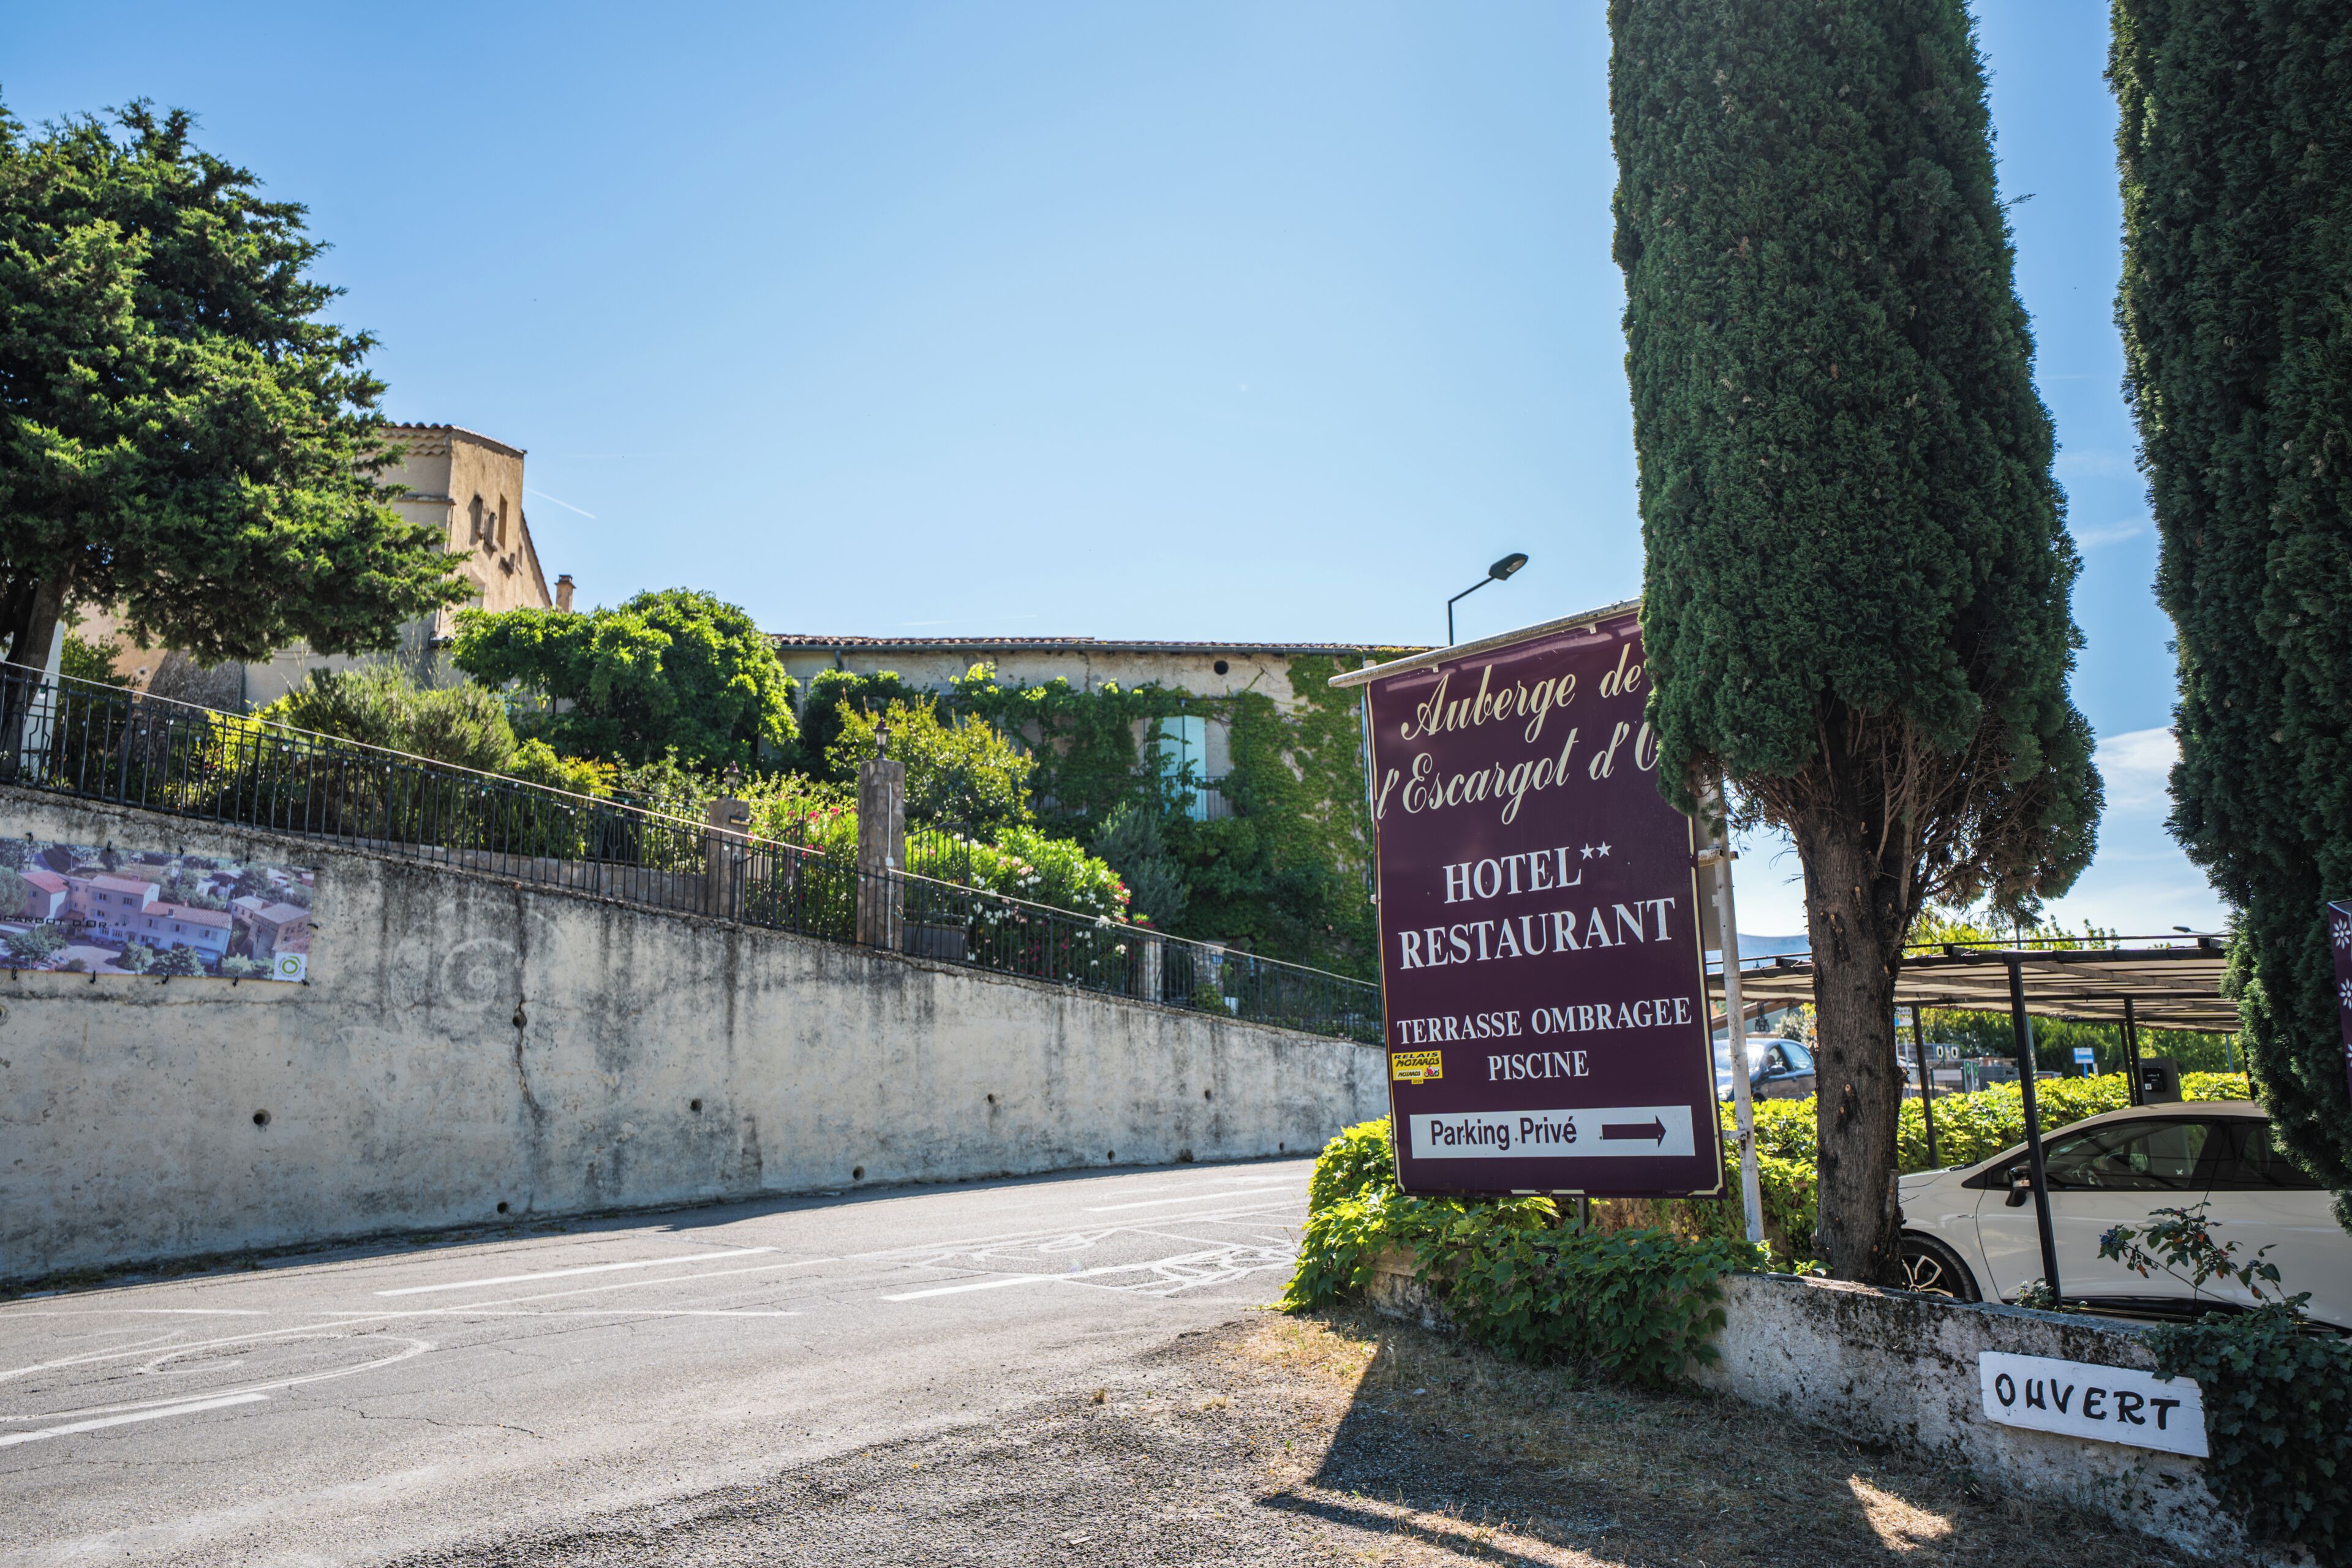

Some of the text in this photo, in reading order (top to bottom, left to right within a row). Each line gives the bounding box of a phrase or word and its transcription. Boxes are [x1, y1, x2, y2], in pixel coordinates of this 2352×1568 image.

[1400, 643, 1642, 744] Auberge de
[1376, 728, 1579, 824] l'Escargot
[1442, 846, 1581, 904] HOTEL
[1398, 897, 1675, 970] RESTAURANT
[1396, 997, 1692, 1044] TERRASSE OMBRAGEE
[1396, 1058, 1440, 1067] MOTARDS
[1488, 1050, 1589, 1081] PISCINE
[1430, 1116, 1577, 1151] Parking Privé
[1995, 1373, 2180, 1430] OUVERT
